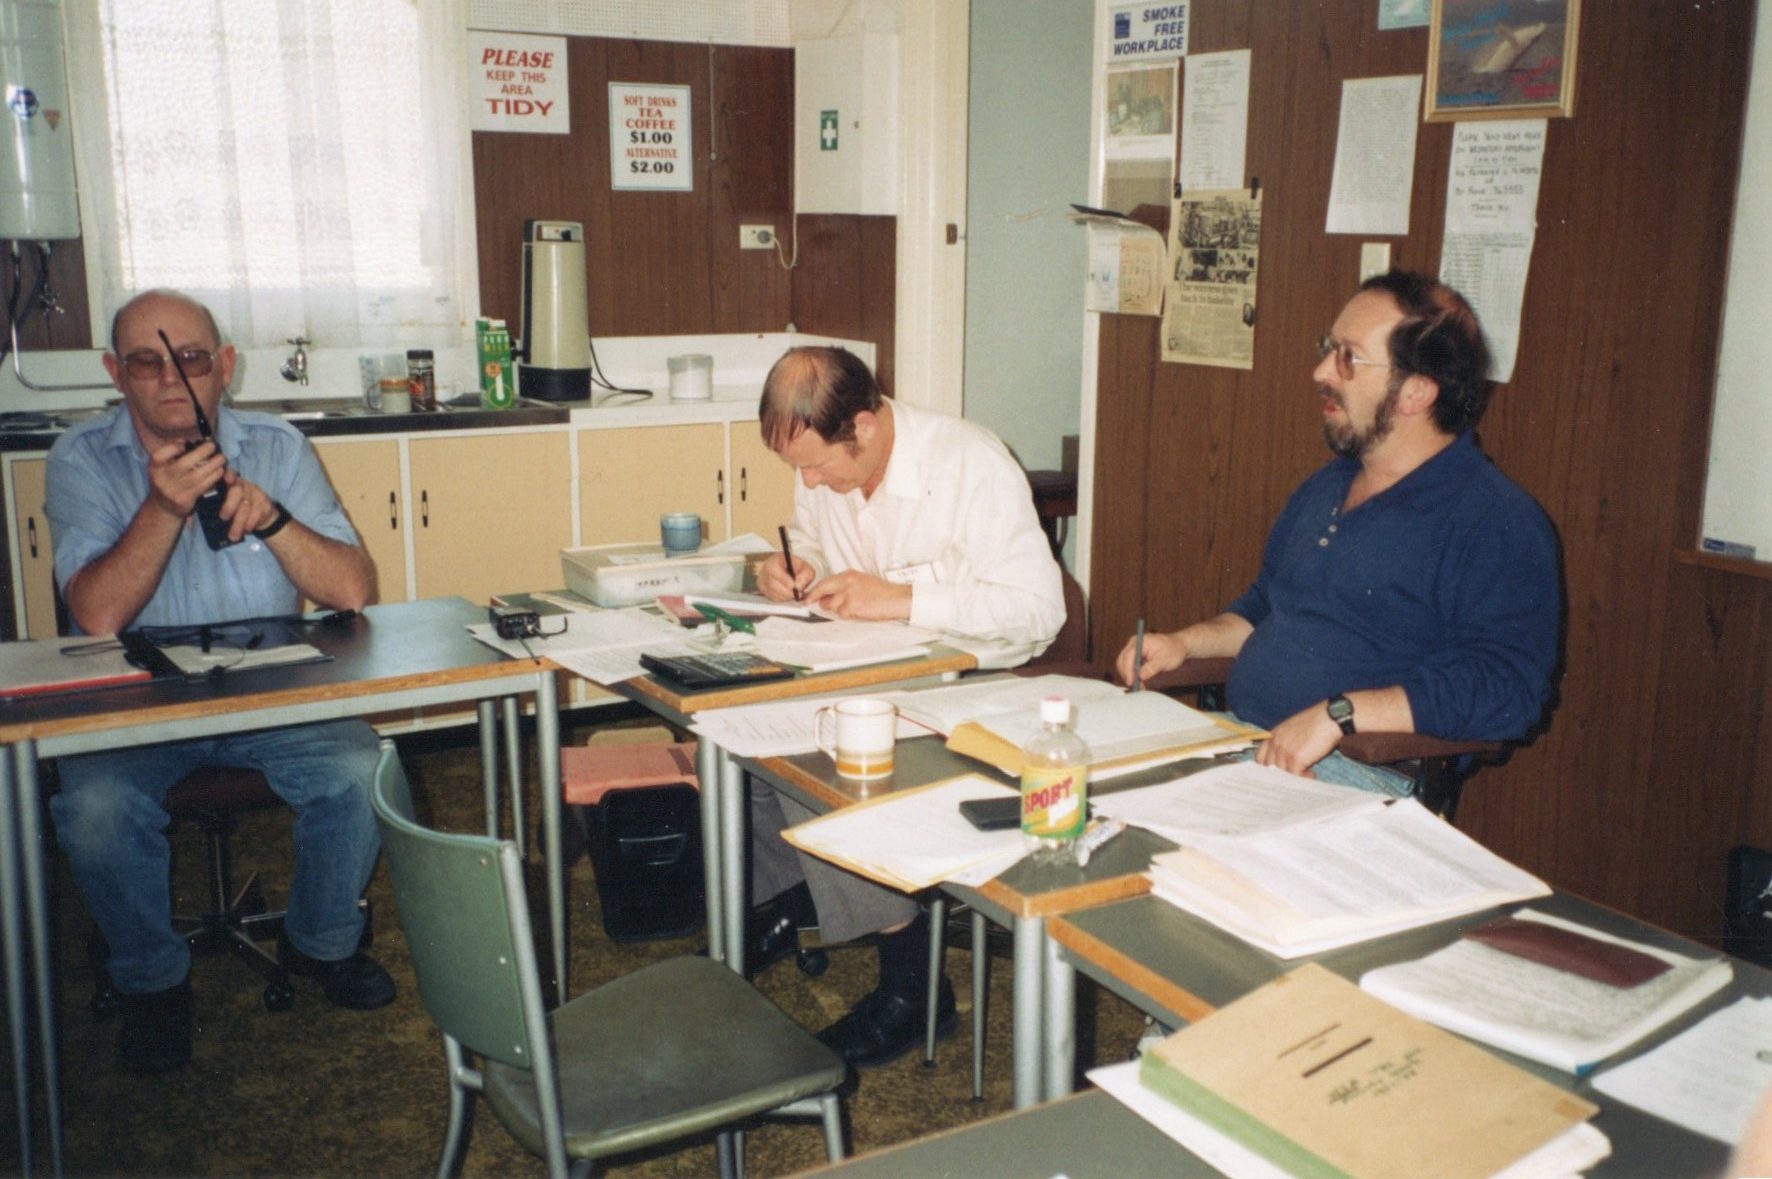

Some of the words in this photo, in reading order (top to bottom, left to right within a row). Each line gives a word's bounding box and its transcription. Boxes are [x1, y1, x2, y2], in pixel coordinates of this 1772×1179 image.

[1143, 5, 1185, 22] SMOKE
[1154, 21, 1184, 36] FREE
[1114, 37, 1184, 55] WORKPLACE
[481, 48, 554, 68] PLEASE
[486, 69, 515, 81] KEEP
[521, 71, 546, 83] THIS
[501, 84, 533, 96] AREA
[485, 98, 554, 116] TIDY
[624, 95, 644, 106] SOFT
[647, 96, 677, 108] DRINKS
[637, 108, 663, 118] TEA
[626, 118, 676, 130] COFFEE
[630, 131, 673, 144] $1.00
[625, 148, 677, 159] ALTERNATIVE
[630, 161, 674, 174] $2.00
[1024, 776, 1073, 814] SPORT
